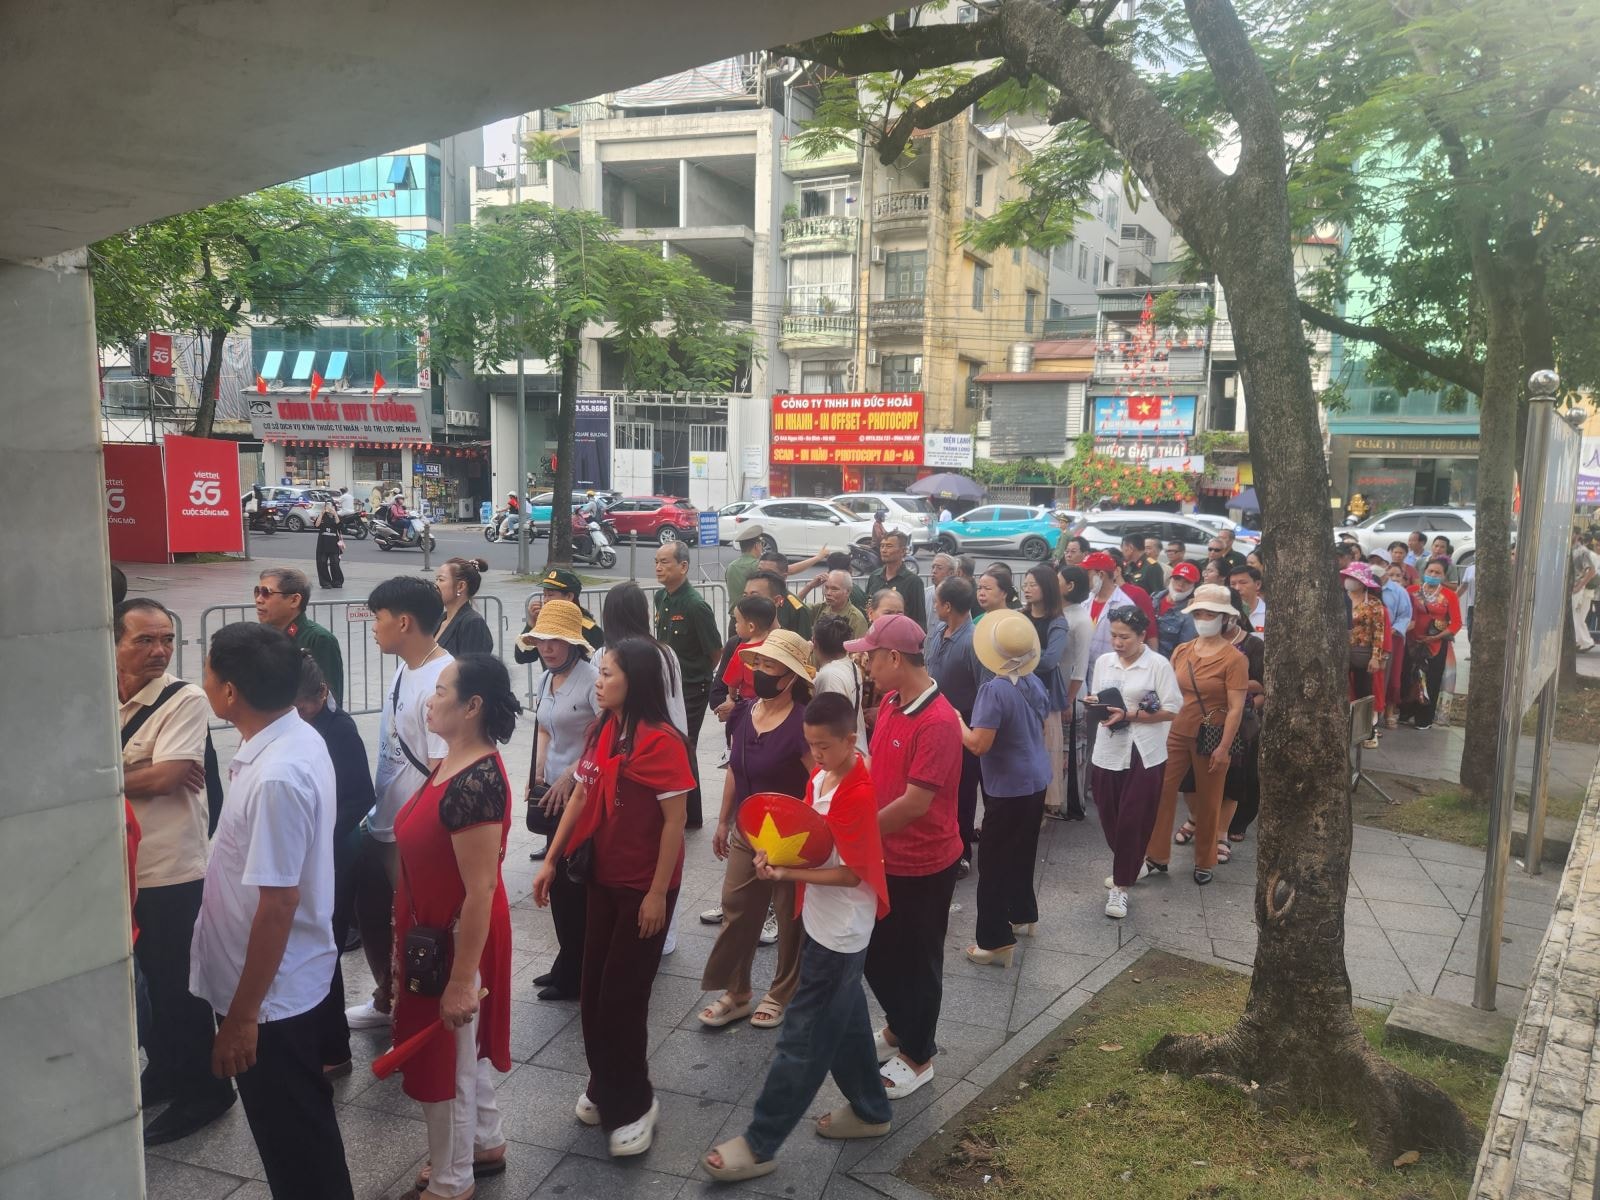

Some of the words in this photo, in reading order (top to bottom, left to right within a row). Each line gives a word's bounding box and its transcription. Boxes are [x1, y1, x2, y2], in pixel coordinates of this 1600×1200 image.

[152, 350, 169, 364] 5G
[781, 398, 809, 408] CÔNG
[811, 399, 821, 408] TY
[823, 398, 849, 408] TNHH
[851, 398, 861, 408] IN
[863, 395, 884, 408] ĐỨC
[277, 399, 311, 420] KÍNH
[311, 396, 340, 421] MẮT
[775, 413, 784, 430] IN
[785, 413, 813, 430] NHANH
[820, 412, 830, 430] IN
[831, 412, 861, 430] OFFSET
[868, 411, 919, 430] PHOTOCOPY
[280, 423, 293, 431] DỊCH
[293, 423, 301, 431] VỤ
[302, 423, 316, 431] KÍNH
[316, 423, 335, 431] THUỐC
[343, 424, 360, 432] NHÂN
[383, 425, 395, 434] LỰC
[396, 424, 411, 433] MIỄN
[774, 449, 794, 460] SCAN
[800, 450, 810, 460] IN
[810, 448, 828, 461] MÀU
[834, 450, 882, 461] PHOTOCOPY
[194, 472, 220, 480] viettel
[189, 481, 221, 506] 5G
[106, 488, 126, 513] G
[182, 508, 198, 517] CUỘC
[199, 508, 216, 516] SỐNG
[216, 508, 230, 516] MỚI
[108, 516, 122, 524] ỐNG
